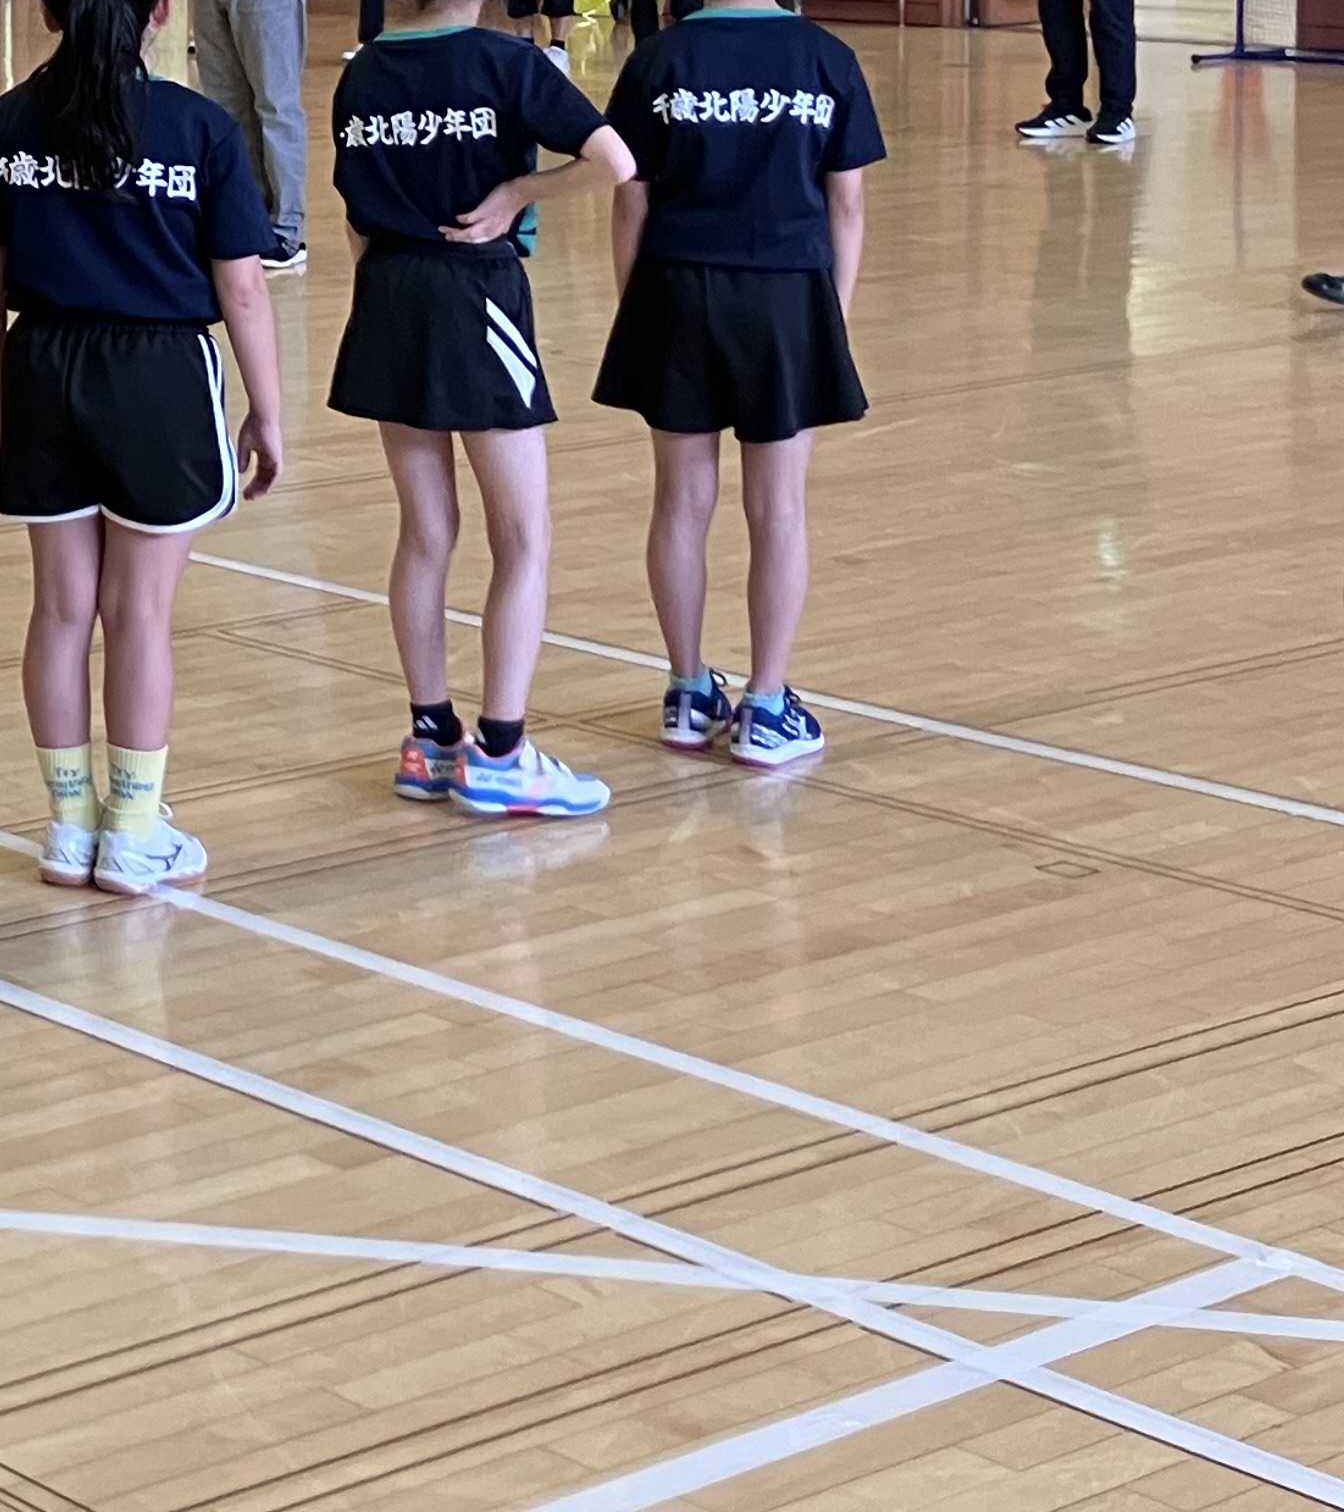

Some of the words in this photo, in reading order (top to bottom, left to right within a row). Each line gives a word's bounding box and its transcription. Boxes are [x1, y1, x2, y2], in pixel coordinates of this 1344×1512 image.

[653, 88, 835, 128] 千歳北陽少年団
